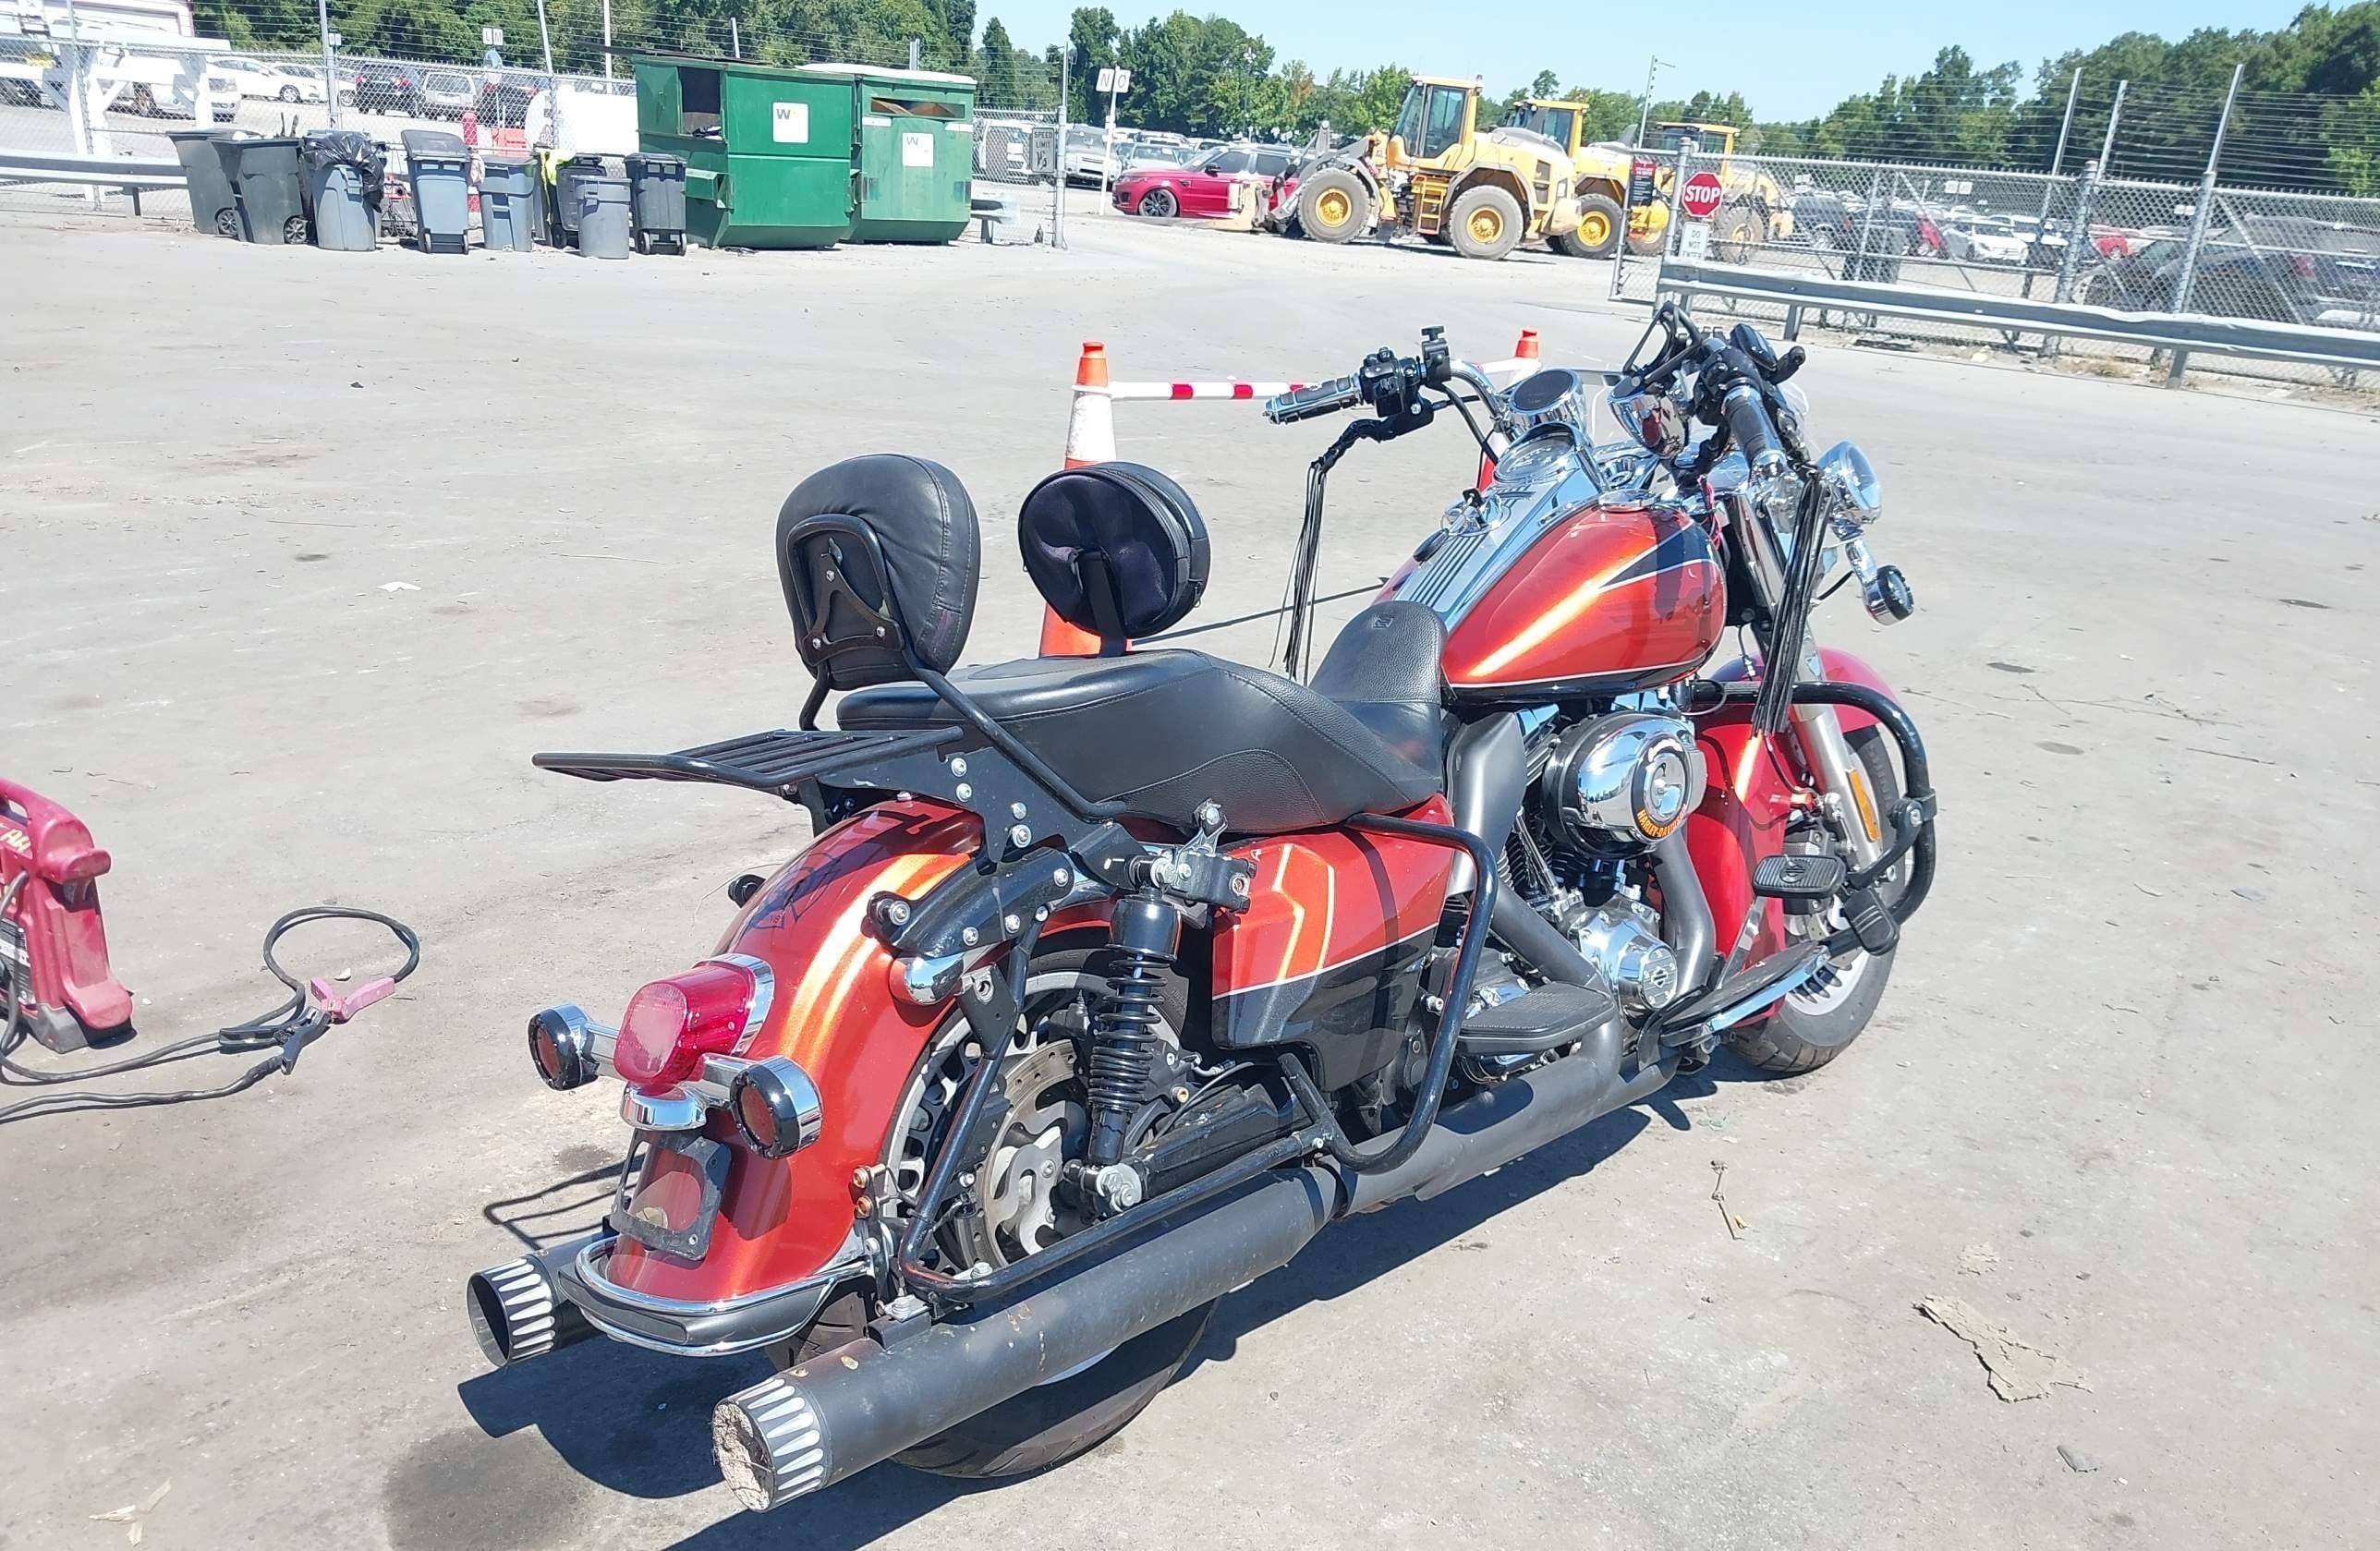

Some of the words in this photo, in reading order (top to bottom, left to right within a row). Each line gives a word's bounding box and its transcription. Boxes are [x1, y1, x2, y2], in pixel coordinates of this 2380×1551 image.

[1100, 73, 1111, 88] N
[1036, 140, 1050, 149] LIMIT
[1684, 185, 1721, 204] STOP
[1692, 229, 1701, 238] DO
[1688, 240, 1701, 250] NOT
